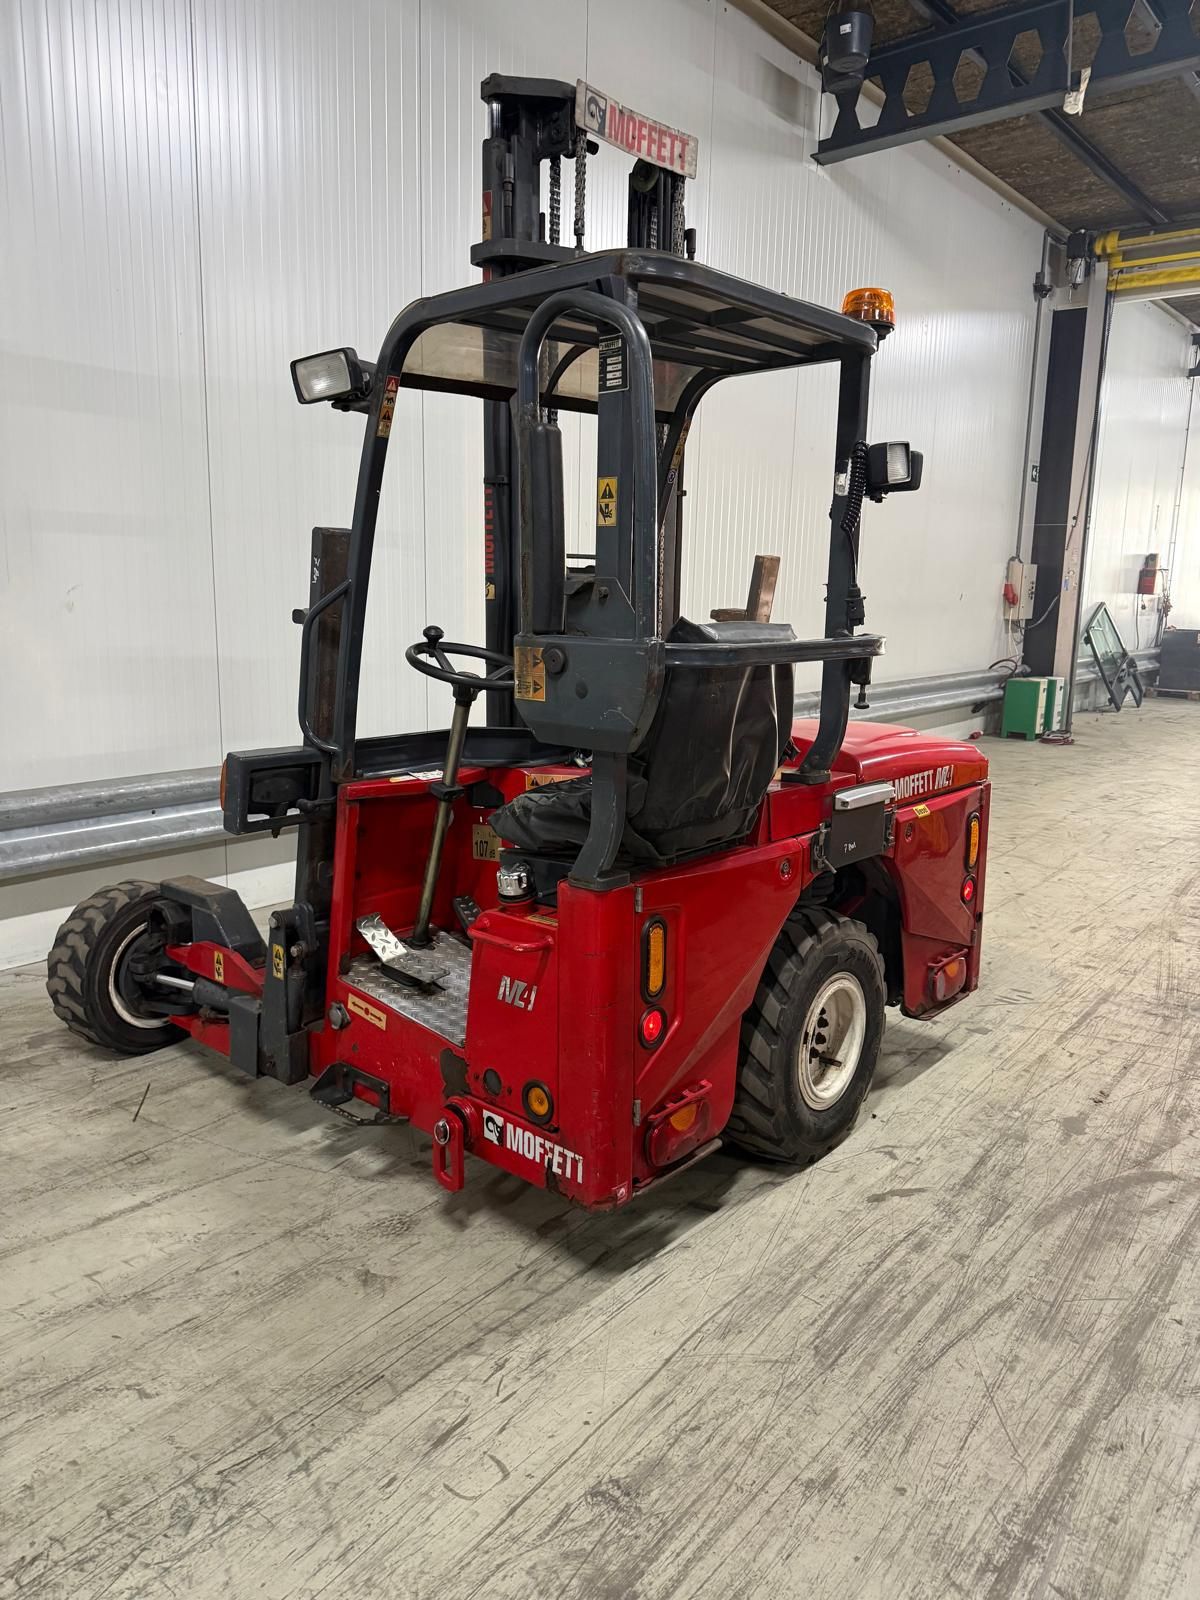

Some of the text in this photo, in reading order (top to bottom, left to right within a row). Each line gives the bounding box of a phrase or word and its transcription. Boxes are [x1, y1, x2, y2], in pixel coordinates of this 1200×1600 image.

[608, 104, 689, 170] MOFFETT
[895, 770, 933, 801] MOFFETT
[475, 840, 488, 857] 107
[505, 1122, 583, 1184] MOFFETT
